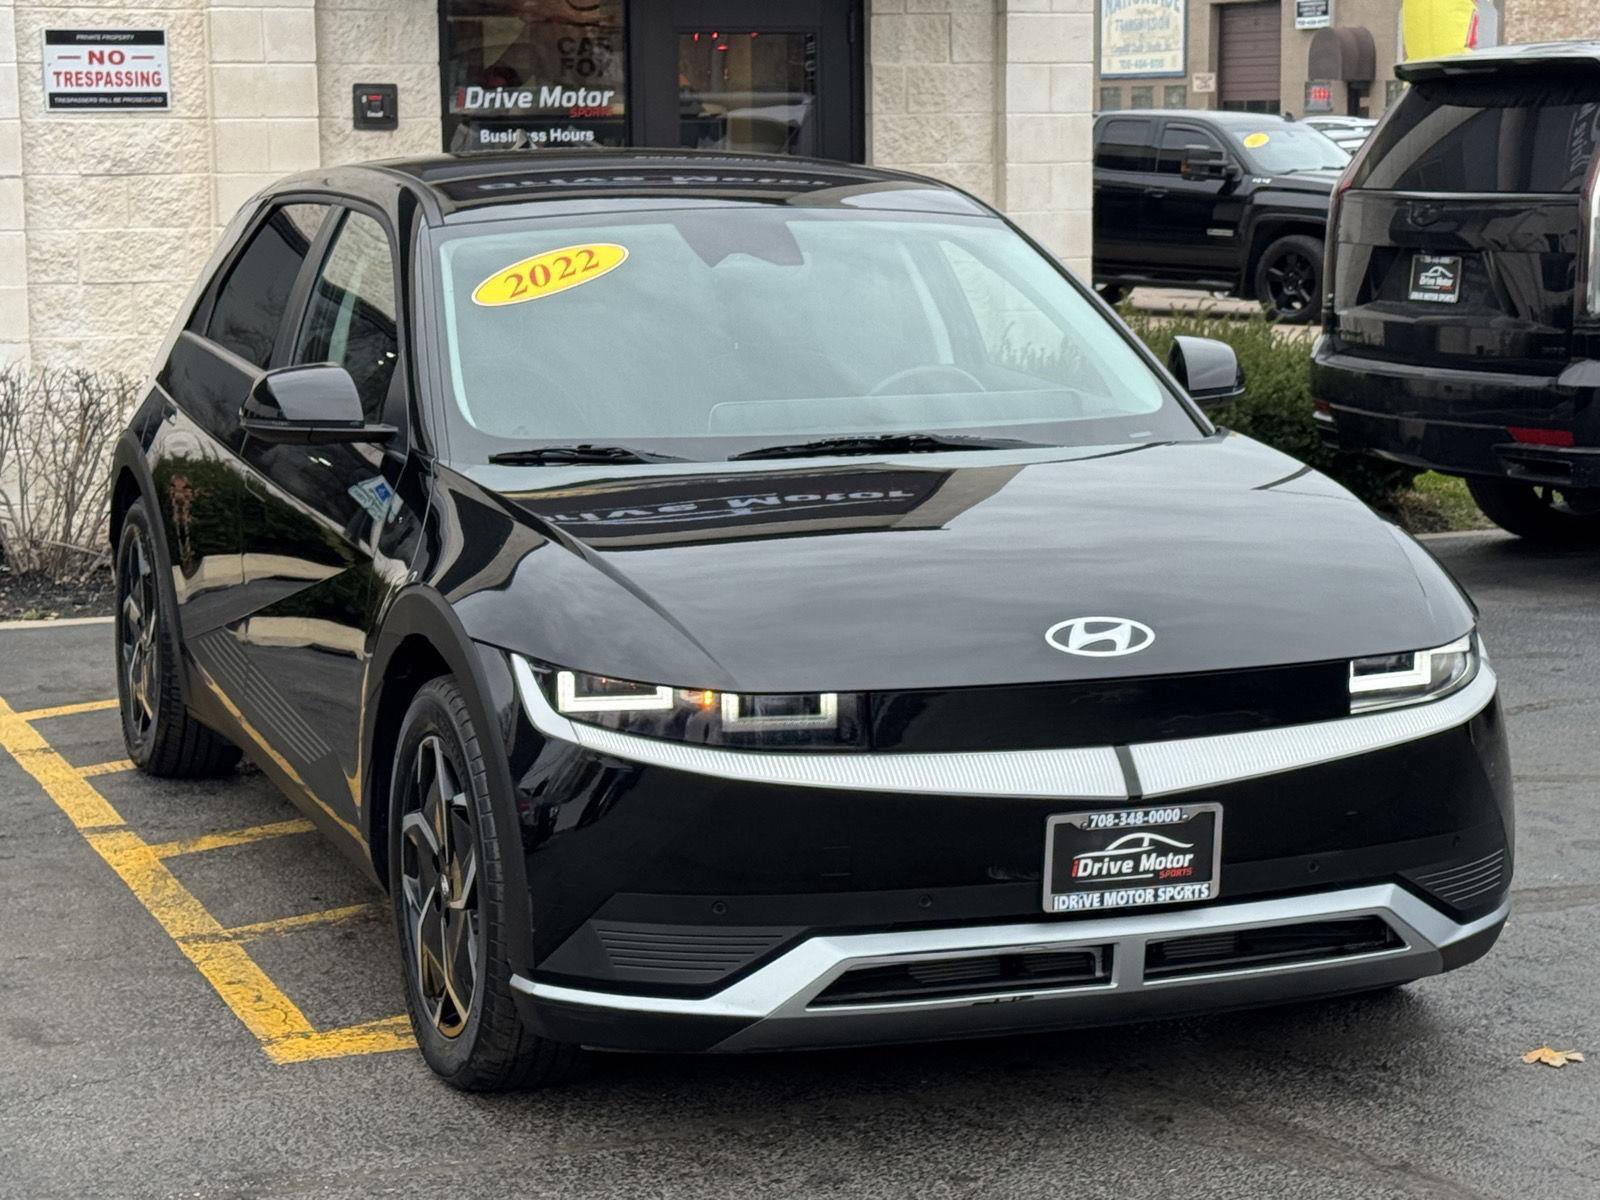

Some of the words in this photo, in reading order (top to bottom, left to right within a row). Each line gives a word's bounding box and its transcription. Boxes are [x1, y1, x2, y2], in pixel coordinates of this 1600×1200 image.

[87, 50, 126, 65] NO
[53, 70, 162, 88] TRESPASSING
[539, 84, 615, 108] Motor
[568, 106, 615, 119] SPORT
[480, 128, 547, 143] Busiss
[550, 128, 595, 142] Hours
[503, 248, 600, 299] 2022
[1089, 807, 1181, 829] 708-348-0000
[1071, 857, 1134, 879] iDrive
[1139, 852, 1195, 873] Motor
[1158, 867, 1195, 880] SPORTS
[1103, 888, 1155, 907] MOTOR
[1157, 883, 1210, 903] SPORTS
